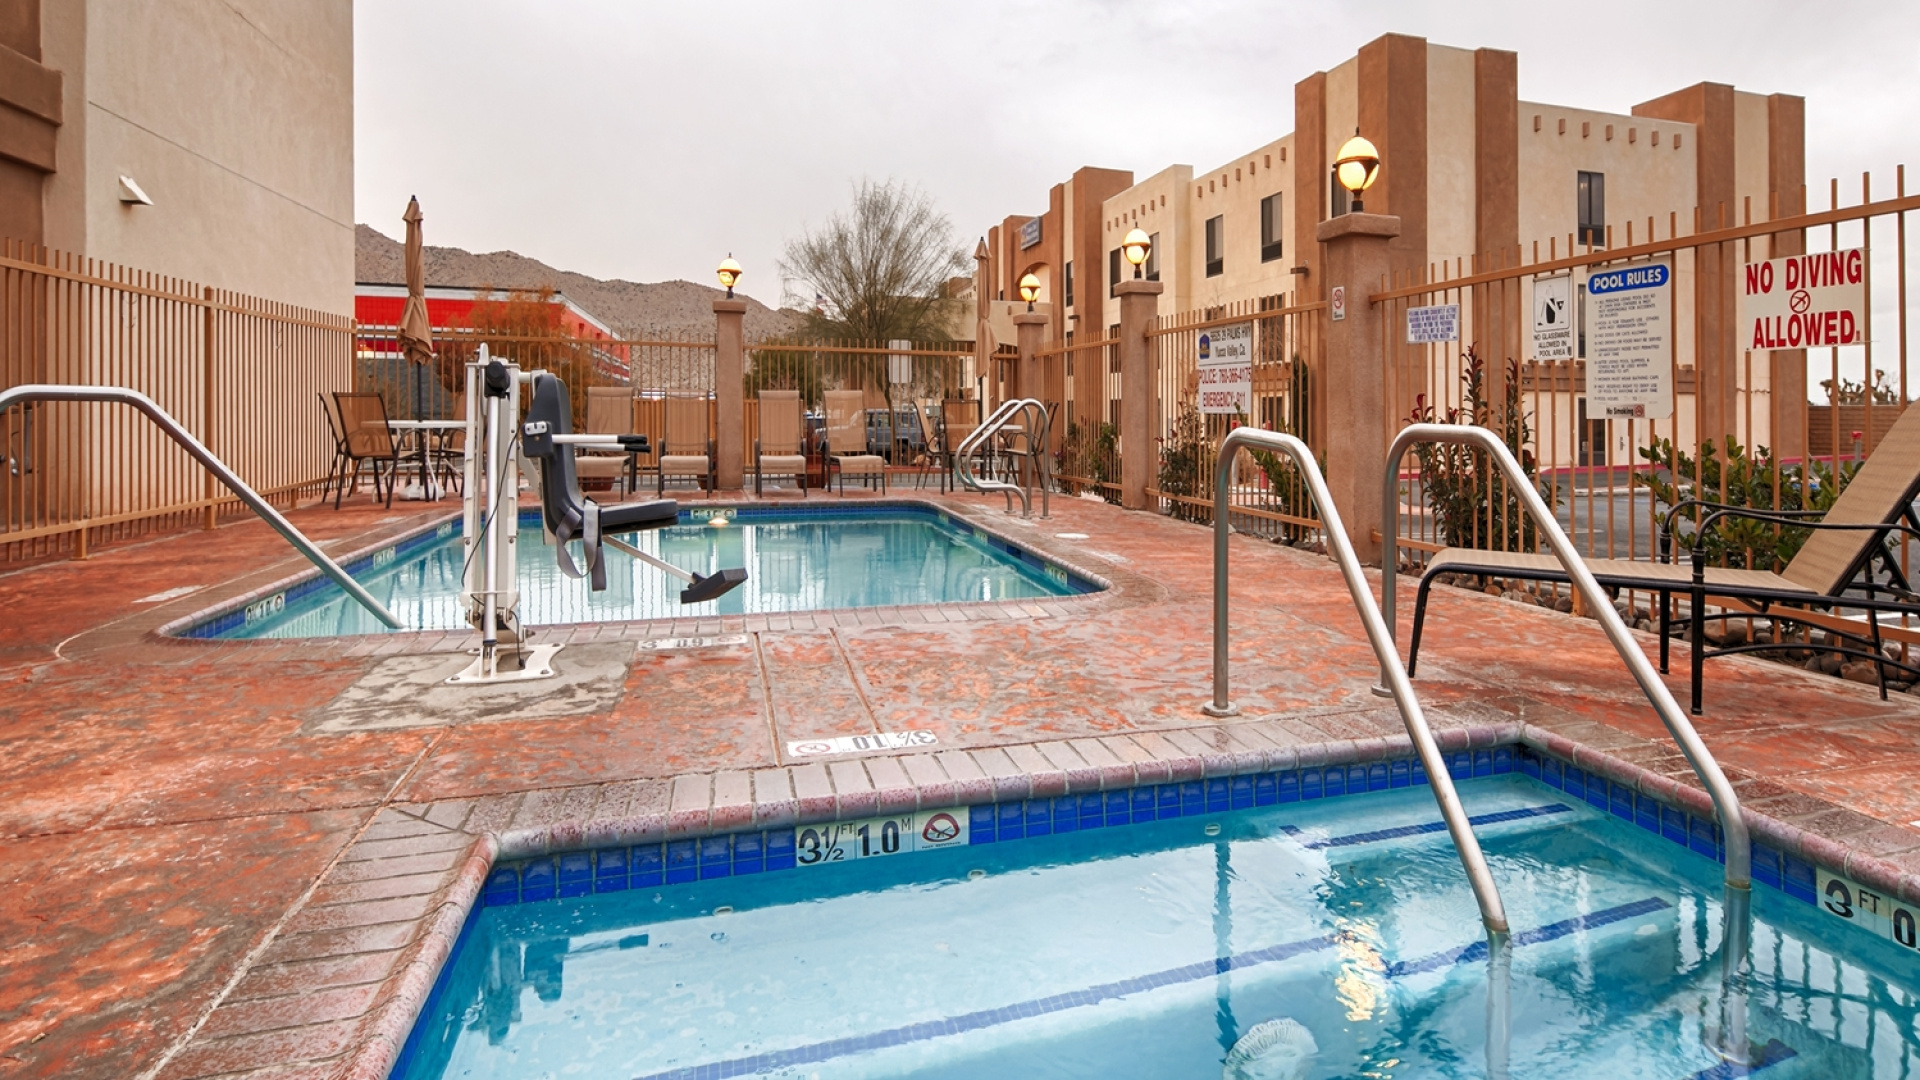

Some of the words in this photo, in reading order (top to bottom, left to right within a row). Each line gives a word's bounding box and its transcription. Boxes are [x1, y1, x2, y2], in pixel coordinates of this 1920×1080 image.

[1594, 275, 1624, 291] POOL
[1627, 268, 1662, 286] RULES
[1746, 261, 1774, 295] NO
[1786, 249, 1862, 291] DIVING
[1533, 333, 1541, 341] NO
[1542, 331, 1570, 340] GLASSWARE
[1538, 340, 1560, 349] ALLOWED
[1553, 348, 1566, 356] AREA
[1606, 407, 1613, 415] No
[1614, 406, 1634, 416] Smoking
[840, 823, 854, 835] FT
[857, 820, 900, 857] 1.0
[901, 817, 912, 832] M
[1824, 879, 1854, 918] 3
[1859, 888, 1881, 915] FT
